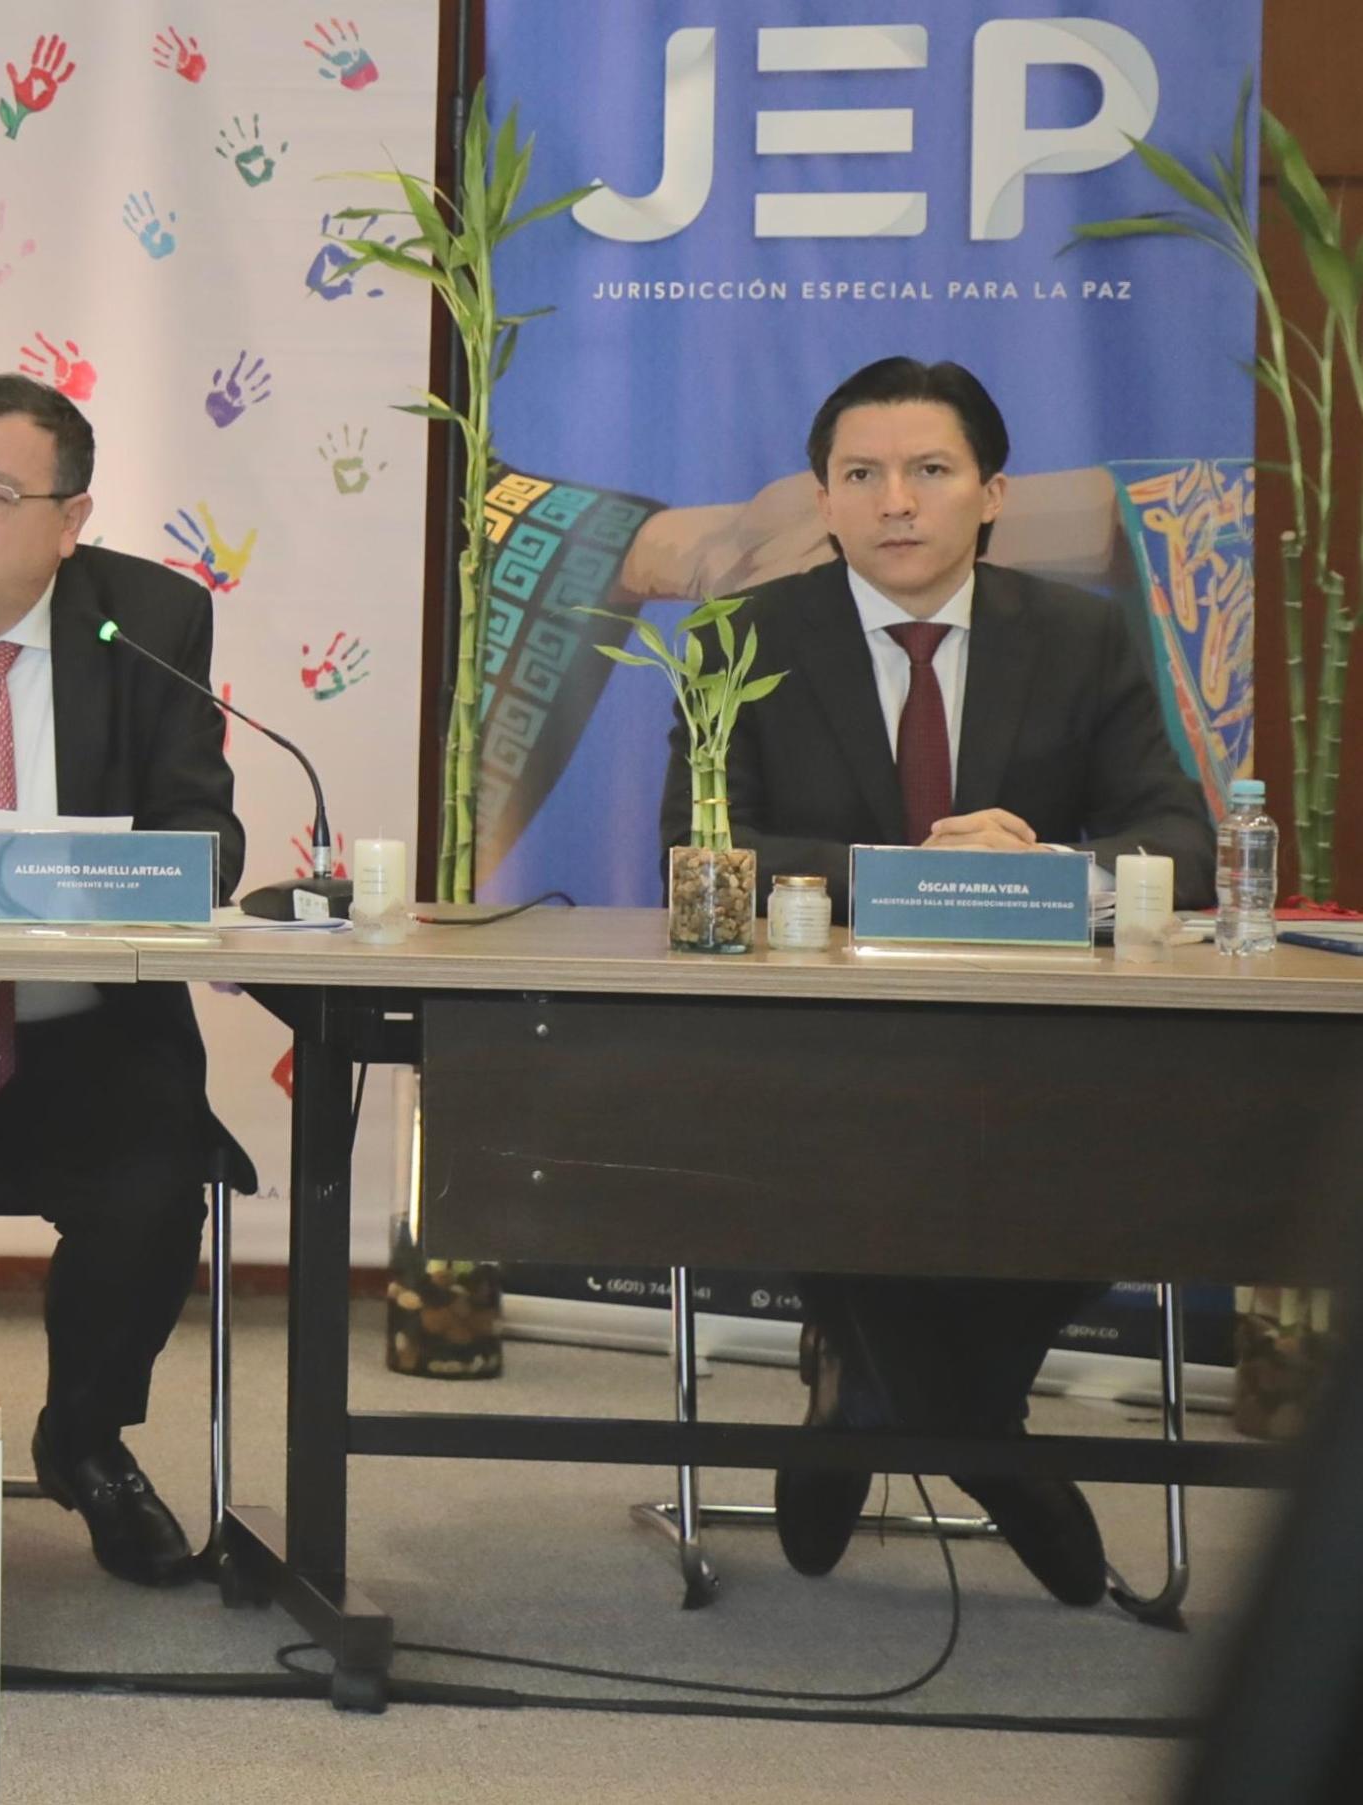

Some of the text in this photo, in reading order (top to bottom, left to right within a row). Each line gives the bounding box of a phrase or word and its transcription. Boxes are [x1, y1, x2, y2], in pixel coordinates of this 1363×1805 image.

[571, 17, 1160, 243] JEP
[593, 278, 1132, 300] JURISDICCIÓN ESPECIAL PARA LA PAZ
[14, 864, 182, 876] ALEJANDRO RAMELLI ARTEAGA
[918, 880, 1030, 895] ÓSCAR PARRA VERA
